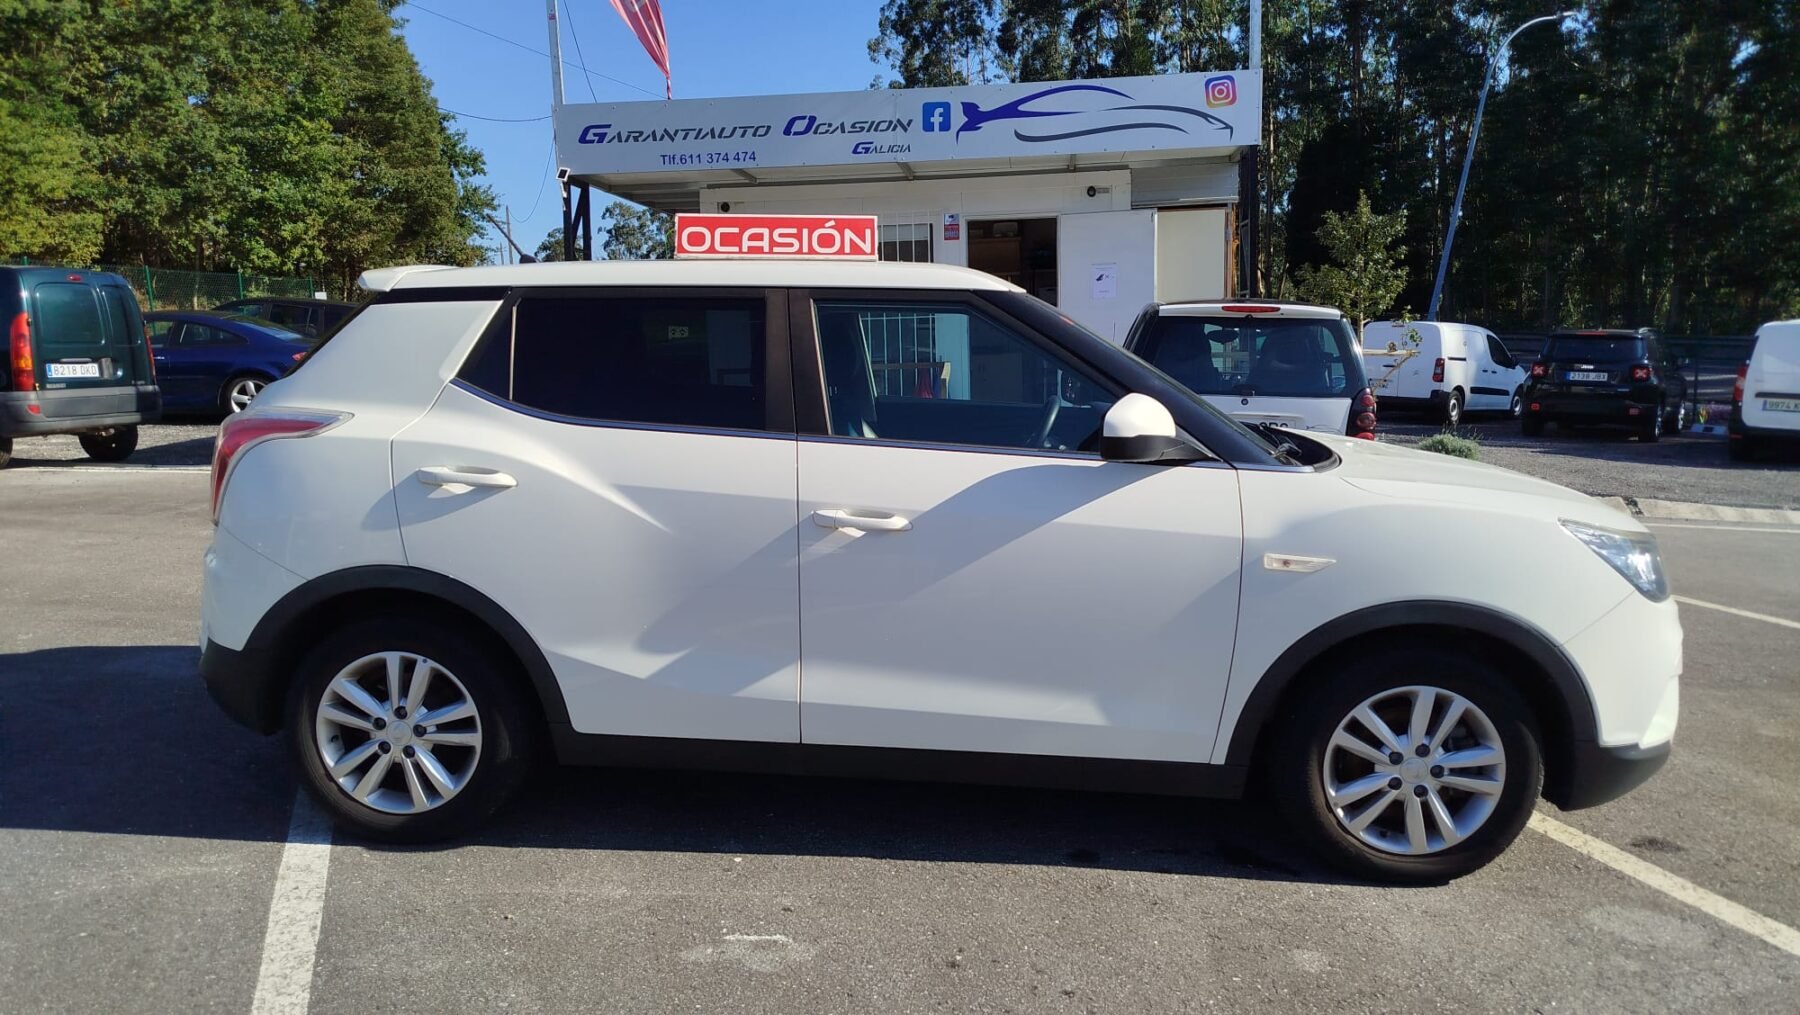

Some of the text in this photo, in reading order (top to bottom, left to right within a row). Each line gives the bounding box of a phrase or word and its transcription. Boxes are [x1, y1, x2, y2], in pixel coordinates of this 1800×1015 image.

[578, 115, 914, 145] GARANTIAUTO OCASION
[660, 151, 757, 166] Tlf.611 374 474
[851, 141, 912, 155] GALICIA
[681, 219, 872, 254] OCASIÓN
